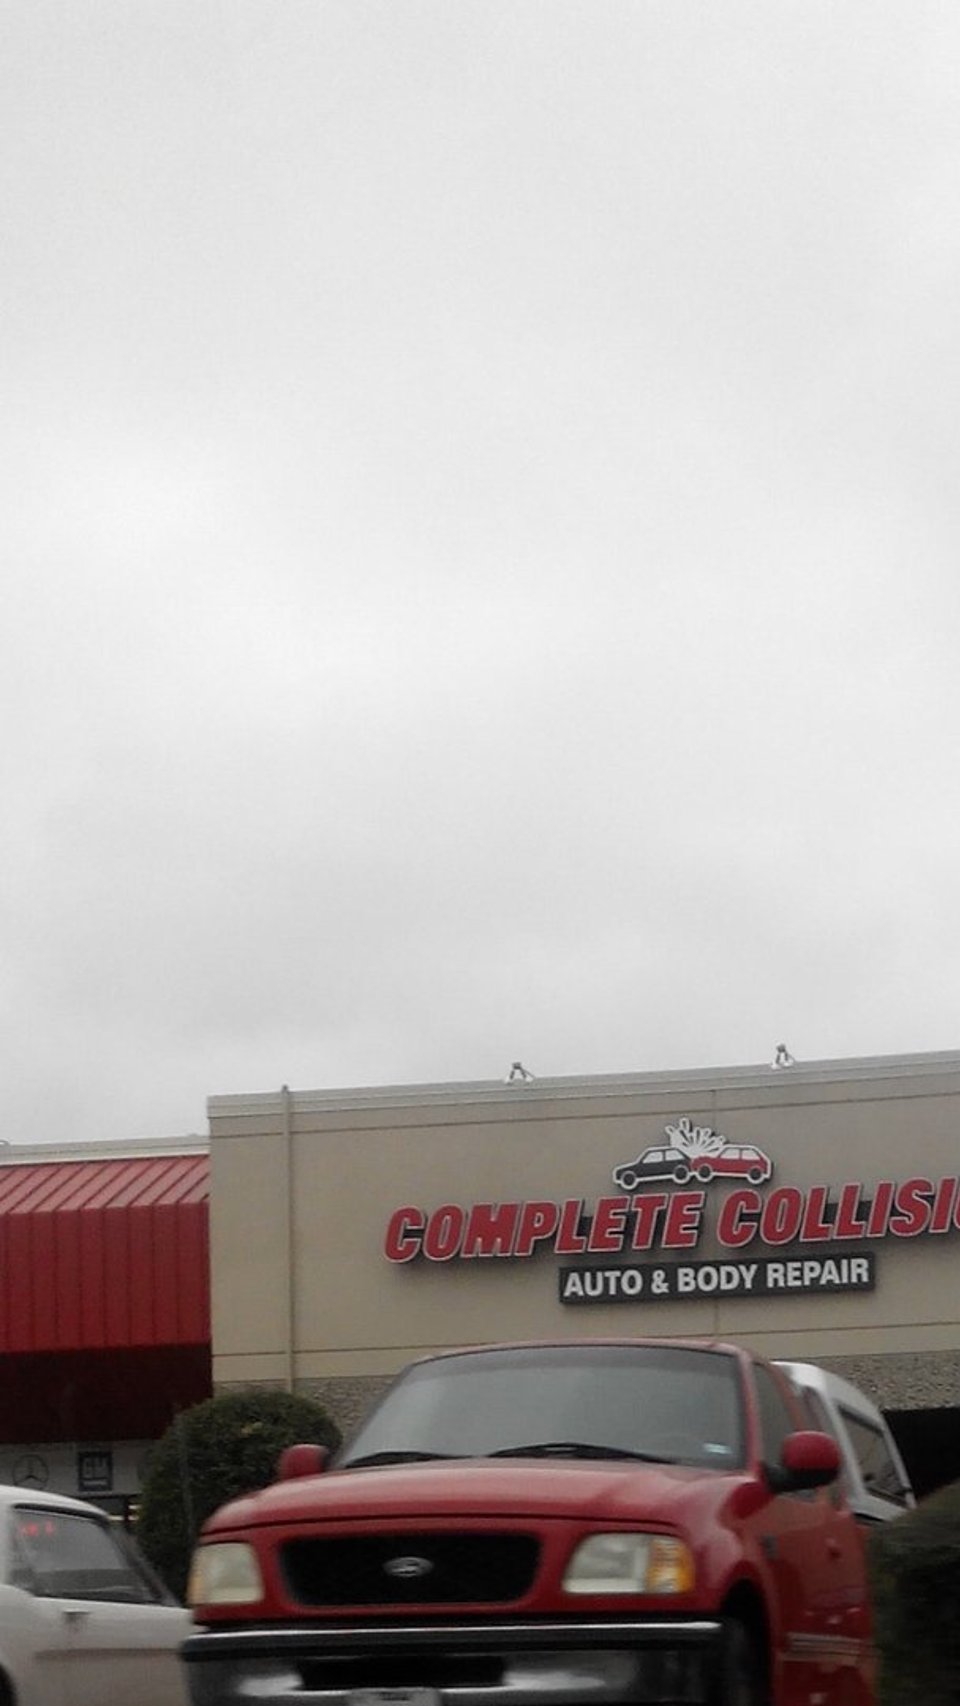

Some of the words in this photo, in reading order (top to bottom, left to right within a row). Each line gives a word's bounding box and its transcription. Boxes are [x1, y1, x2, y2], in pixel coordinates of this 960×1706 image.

[385, 1190, 705, 1262] COMPLETE
[564, 1269, 642, 1298] AUTO
[651, 1269, 670, 1293] &
[678, 1263, 758, 1291] BODY
[767, 1257, 869, 1287] REPAIR
